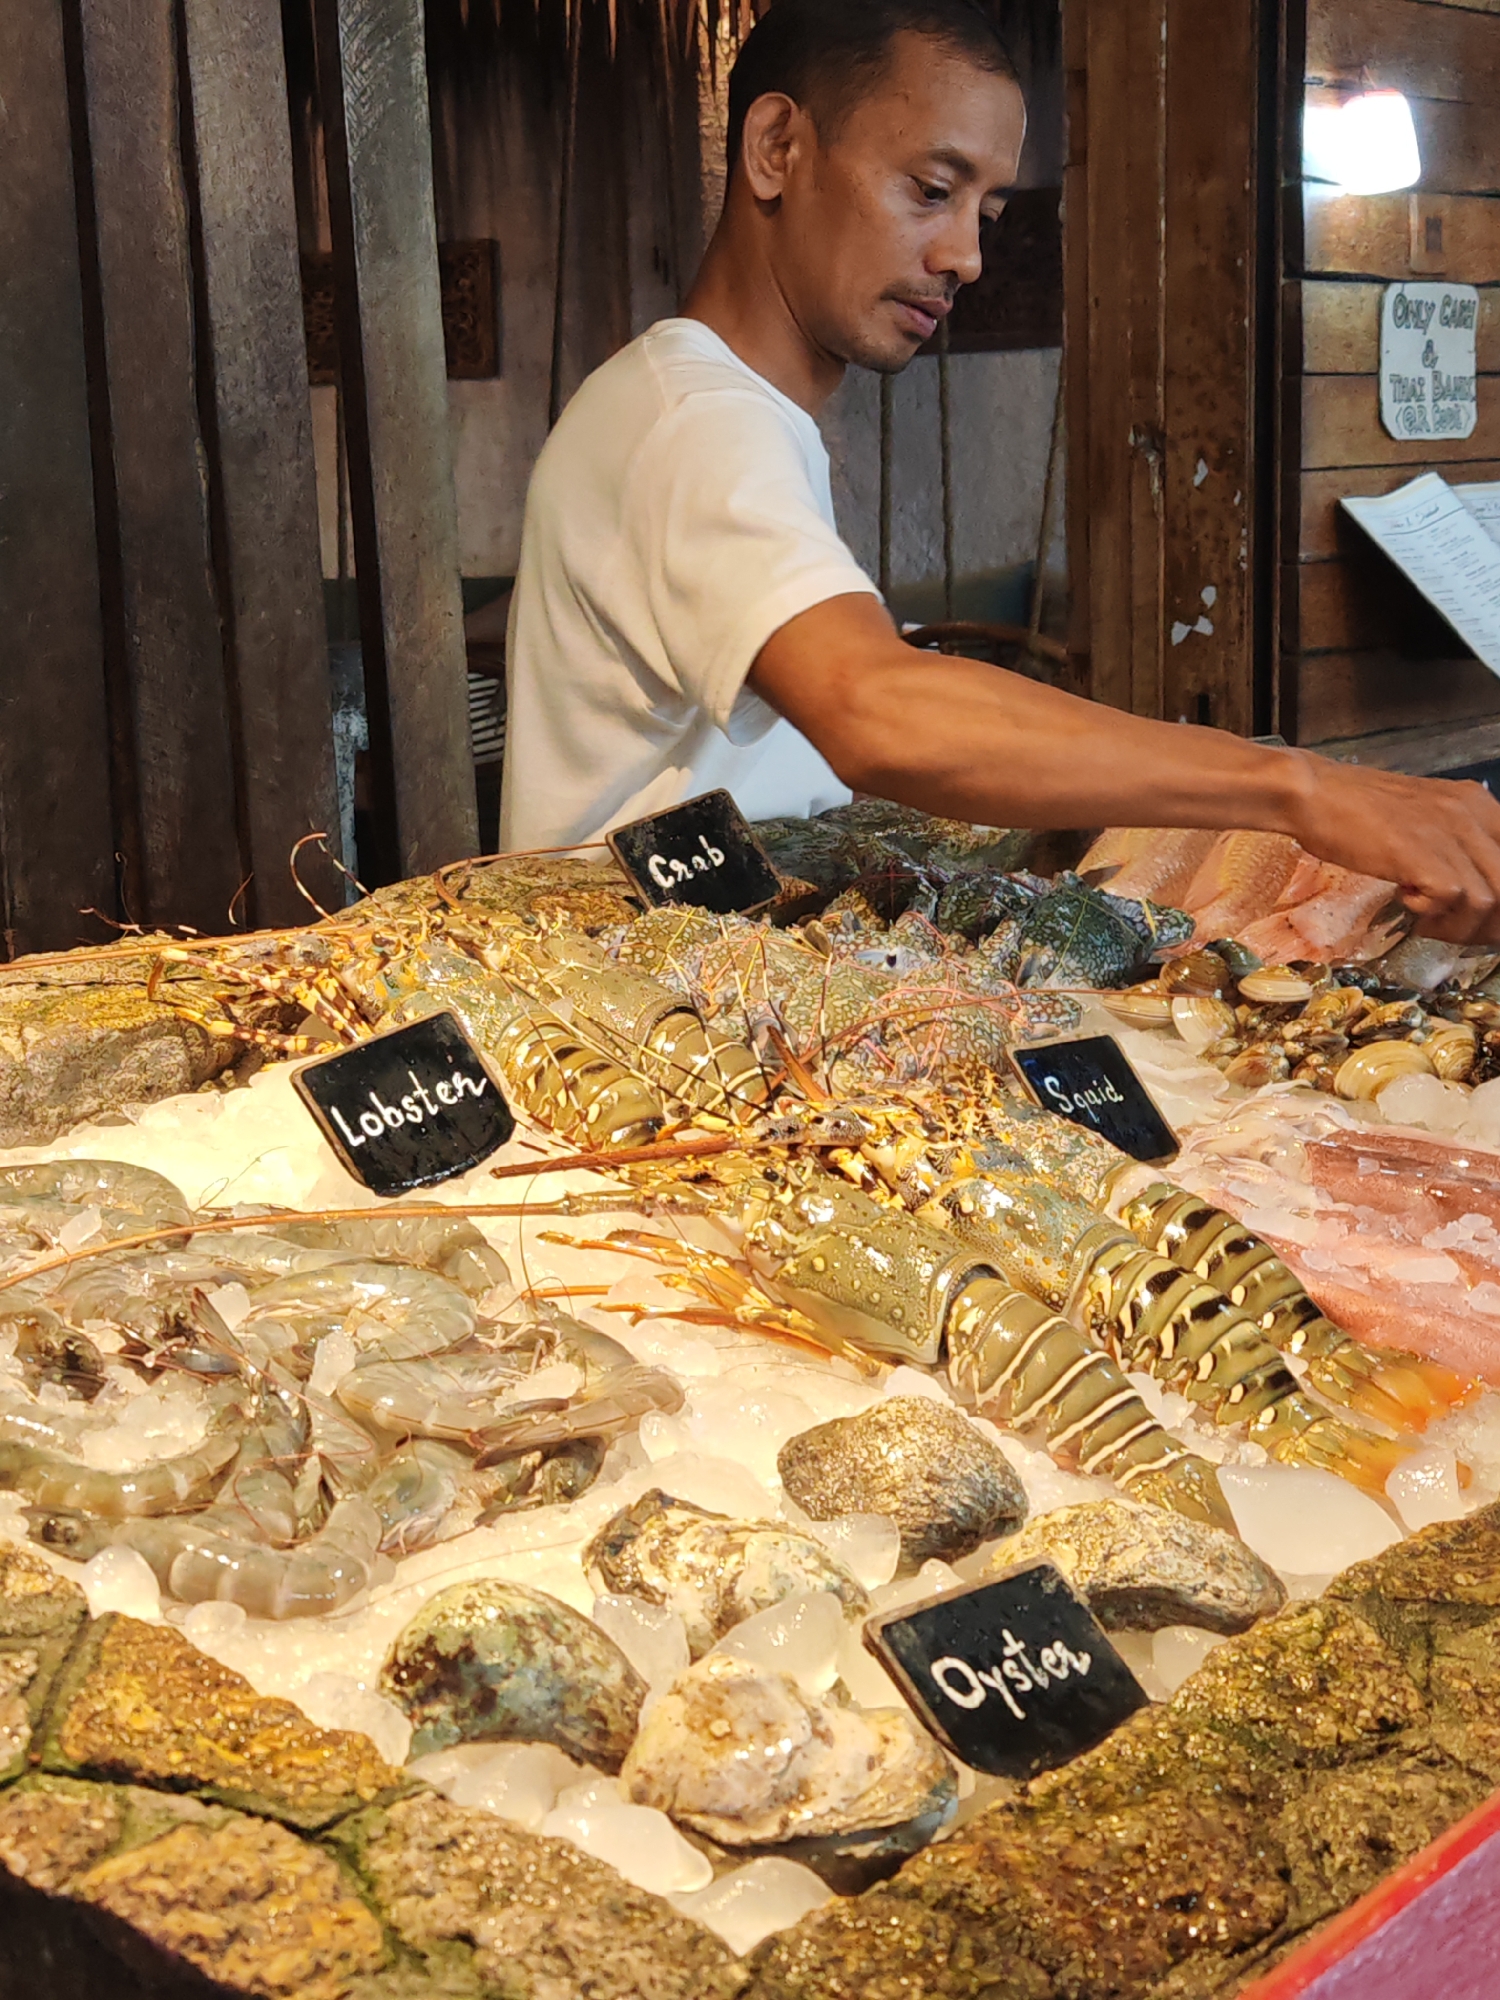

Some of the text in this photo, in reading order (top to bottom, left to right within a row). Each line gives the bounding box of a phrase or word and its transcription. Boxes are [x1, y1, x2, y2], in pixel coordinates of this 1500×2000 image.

[1393, 293, 1476, 335] ONLY CASH
[1421, 339, 1439, 368] &
[1389, 374, 1425, 403] THAI
[648, 835, 725, 888] Crab
[330, 1070, 487, 1146] Lobster
[1044, 1075, 1124, 1123] Squid
[930, 1628, 1091, 1720] Oyster
